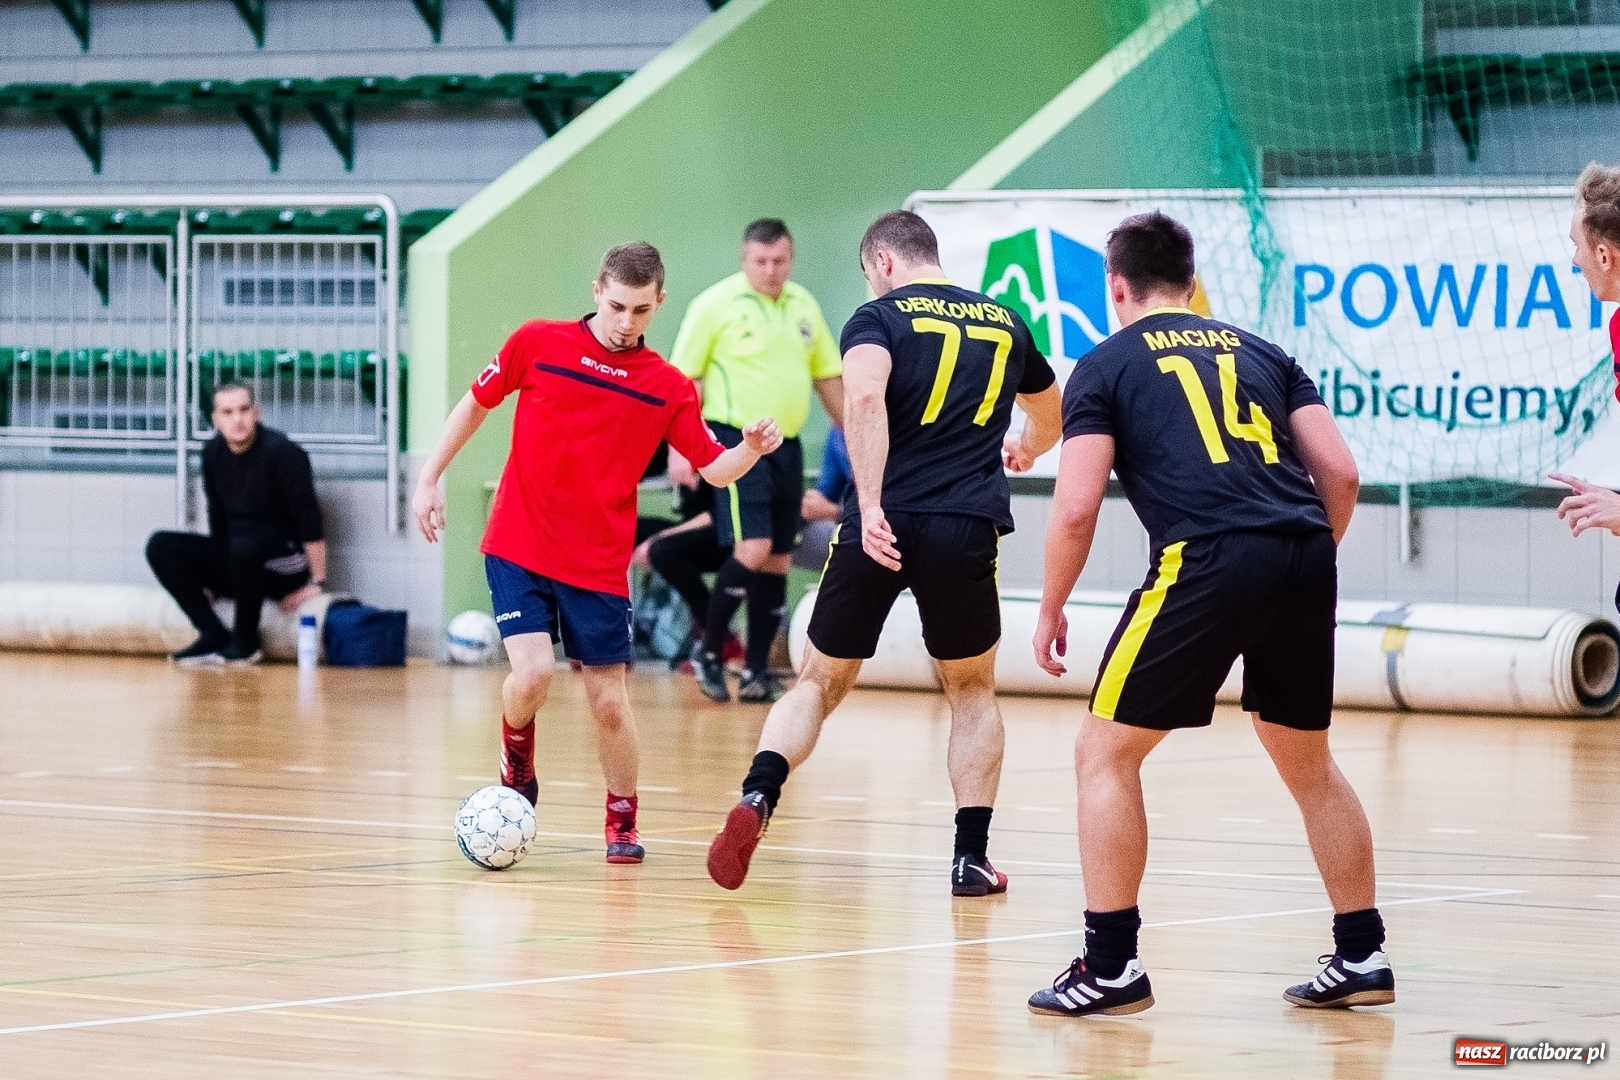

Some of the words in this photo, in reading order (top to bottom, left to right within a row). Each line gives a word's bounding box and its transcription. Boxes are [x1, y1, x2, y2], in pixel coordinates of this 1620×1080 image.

[895, 297, 1014, 327] DERKOWSKI
[1142, 329, 1241, 351] MACIĄG
[911, 317, 1013, 426] 77
[1319, 367, 1594, 435] ibicujemy,
[1156, 353, 1280, 464] 14
